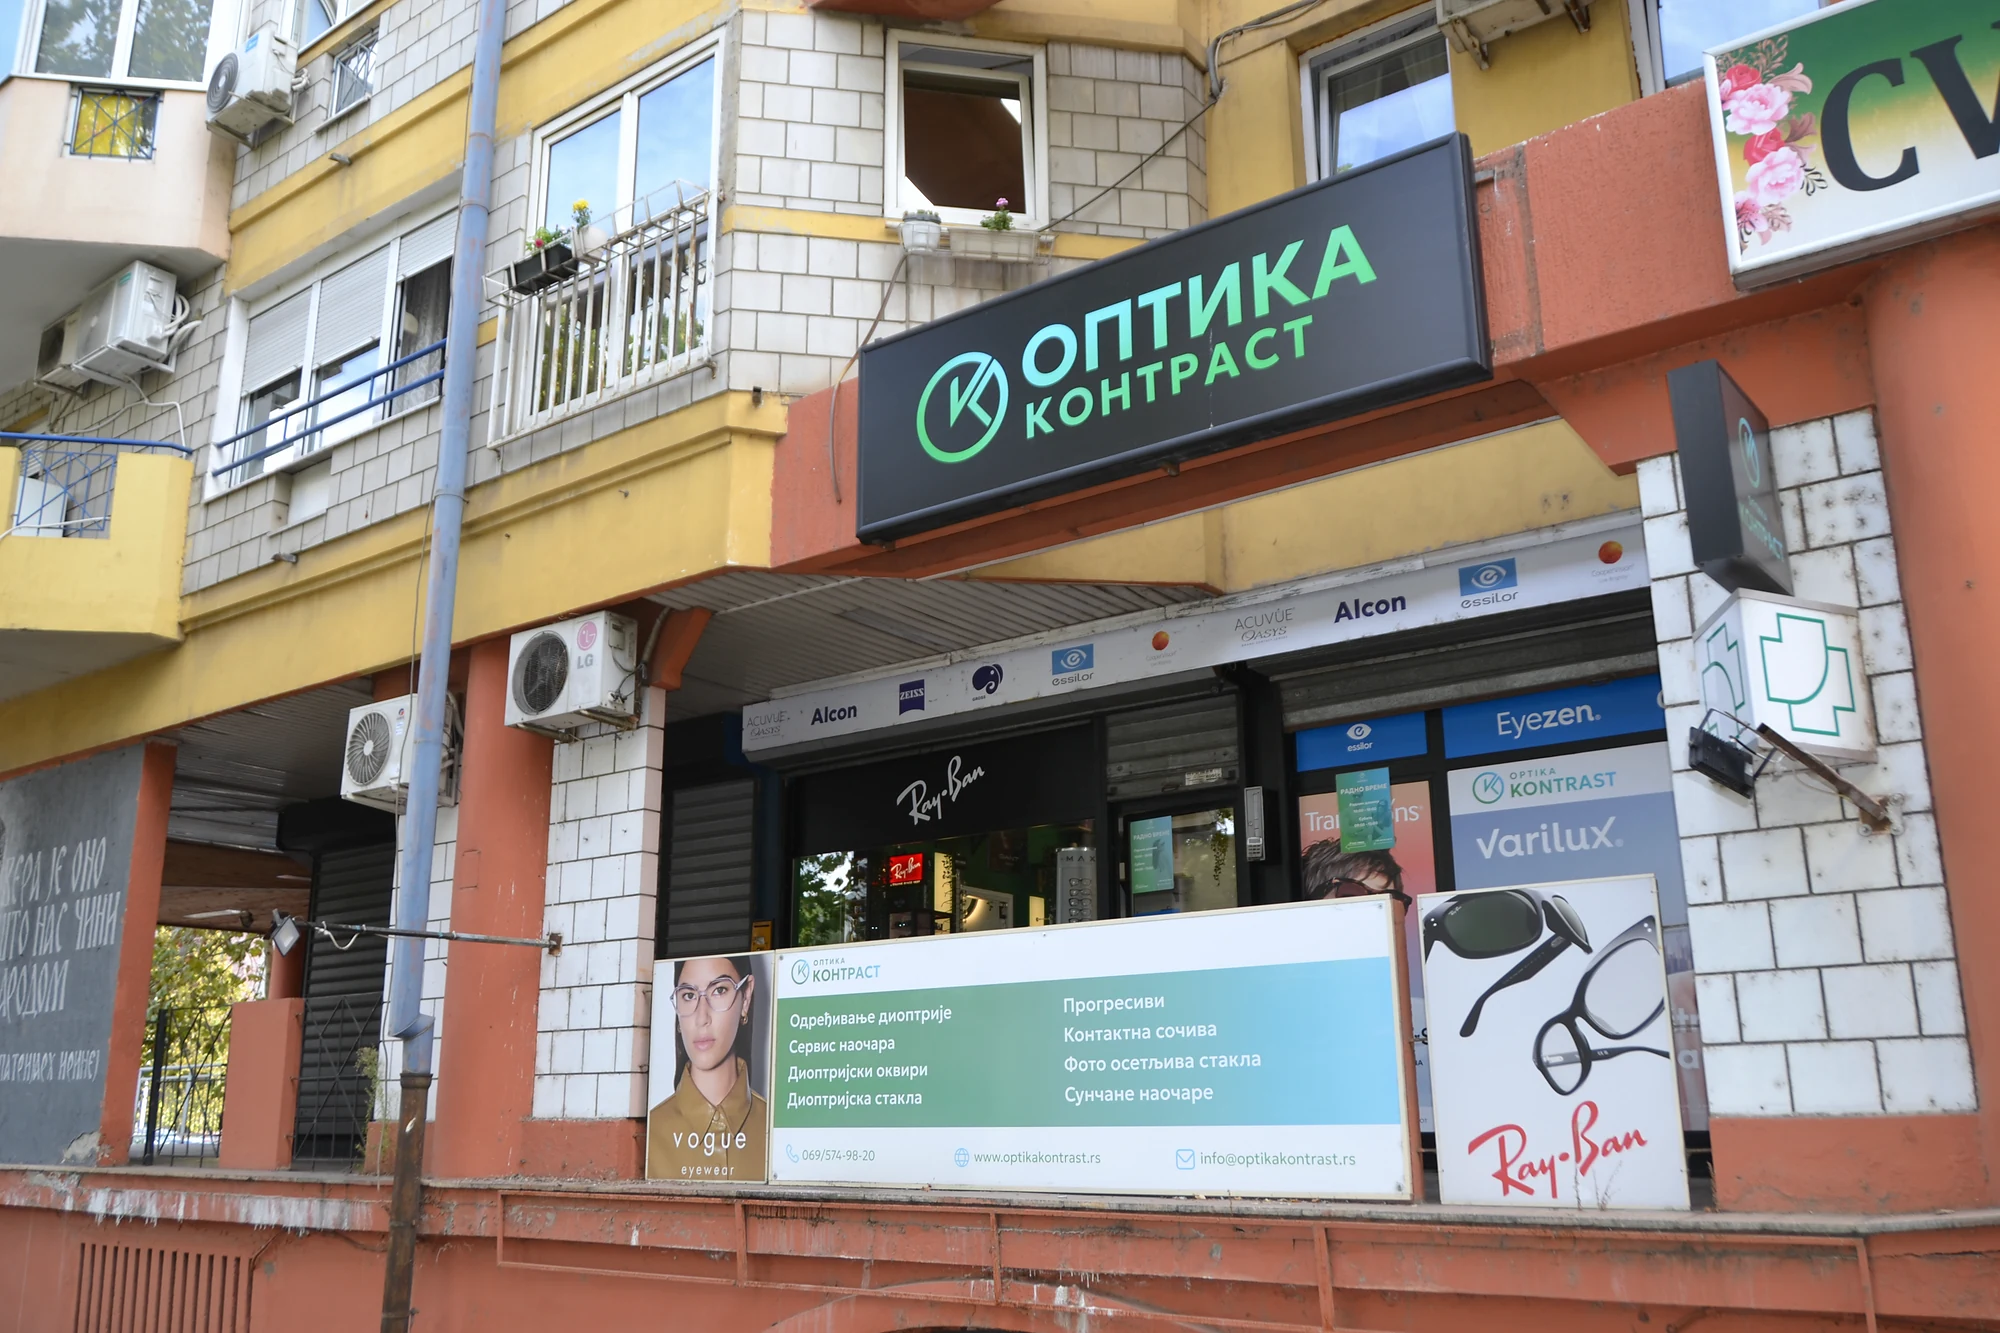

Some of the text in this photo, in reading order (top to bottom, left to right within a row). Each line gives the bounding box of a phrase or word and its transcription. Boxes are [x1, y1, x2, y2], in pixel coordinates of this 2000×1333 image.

[1021, 224, 1378, 388] ОПТИКА
[1025, 315, 1313, 440] КОНТРАСТ
[1334, 595, 1407, 623] Alcon
[1460, 590, 1519, 609] essilor
[1241, 626, 1288, 642] OASYS
[577, 654, 594, 670] LG
[1051, 672, 1094, 686] essilor
[899, 687, 925, 700] ZEISS
[810, 705, 858, 726] Alcon
[1347, 741, 1374, 752] essilor
[1509, 767, 1557, 780] OPTIKA
[1340, 786, 1364, 795] РАДНО
[1510, 771, 1617, 798] KONTRAST
[1476, 816, 1617, 859] Varilux
[72, 837, 107, 893] ОНО
[32, 902, 68, 957] НАС
[75, 891, 120, 950] ЧИНИ
[813, 957, 846, 967] ОПТИКА
[812, 965, 881, 983] КОНТРАСТ
[1063, 996, 1165, 1016] Прогресиви
[790, 1006, 952, 1030] Одређивање диоптрије
[1064, 1023, 1217, 1043] Контактна сочива
[789, 1037, 895, 1056] Сервис наочара
[1064, 1053, 1262, 1073] Фото осетљива стакла
[788, 1064, 928, 1082] Диоптријски оквири
[787, 1091, 923, 1109] Диоптријска стакла
[1064, 1086, 1214, 1106] Сунчане наочаре
[673, 1132, 747, 1156] vogue
[802, 1148, 875, 1162] 069/574-98-20
[974, 1151, 1101, 1166] www.optikakontrast.rs
[1200, 1151, 1356, 1168] info@optikakontrast.rs
[681, 1165, 735, 1179] eyewear
